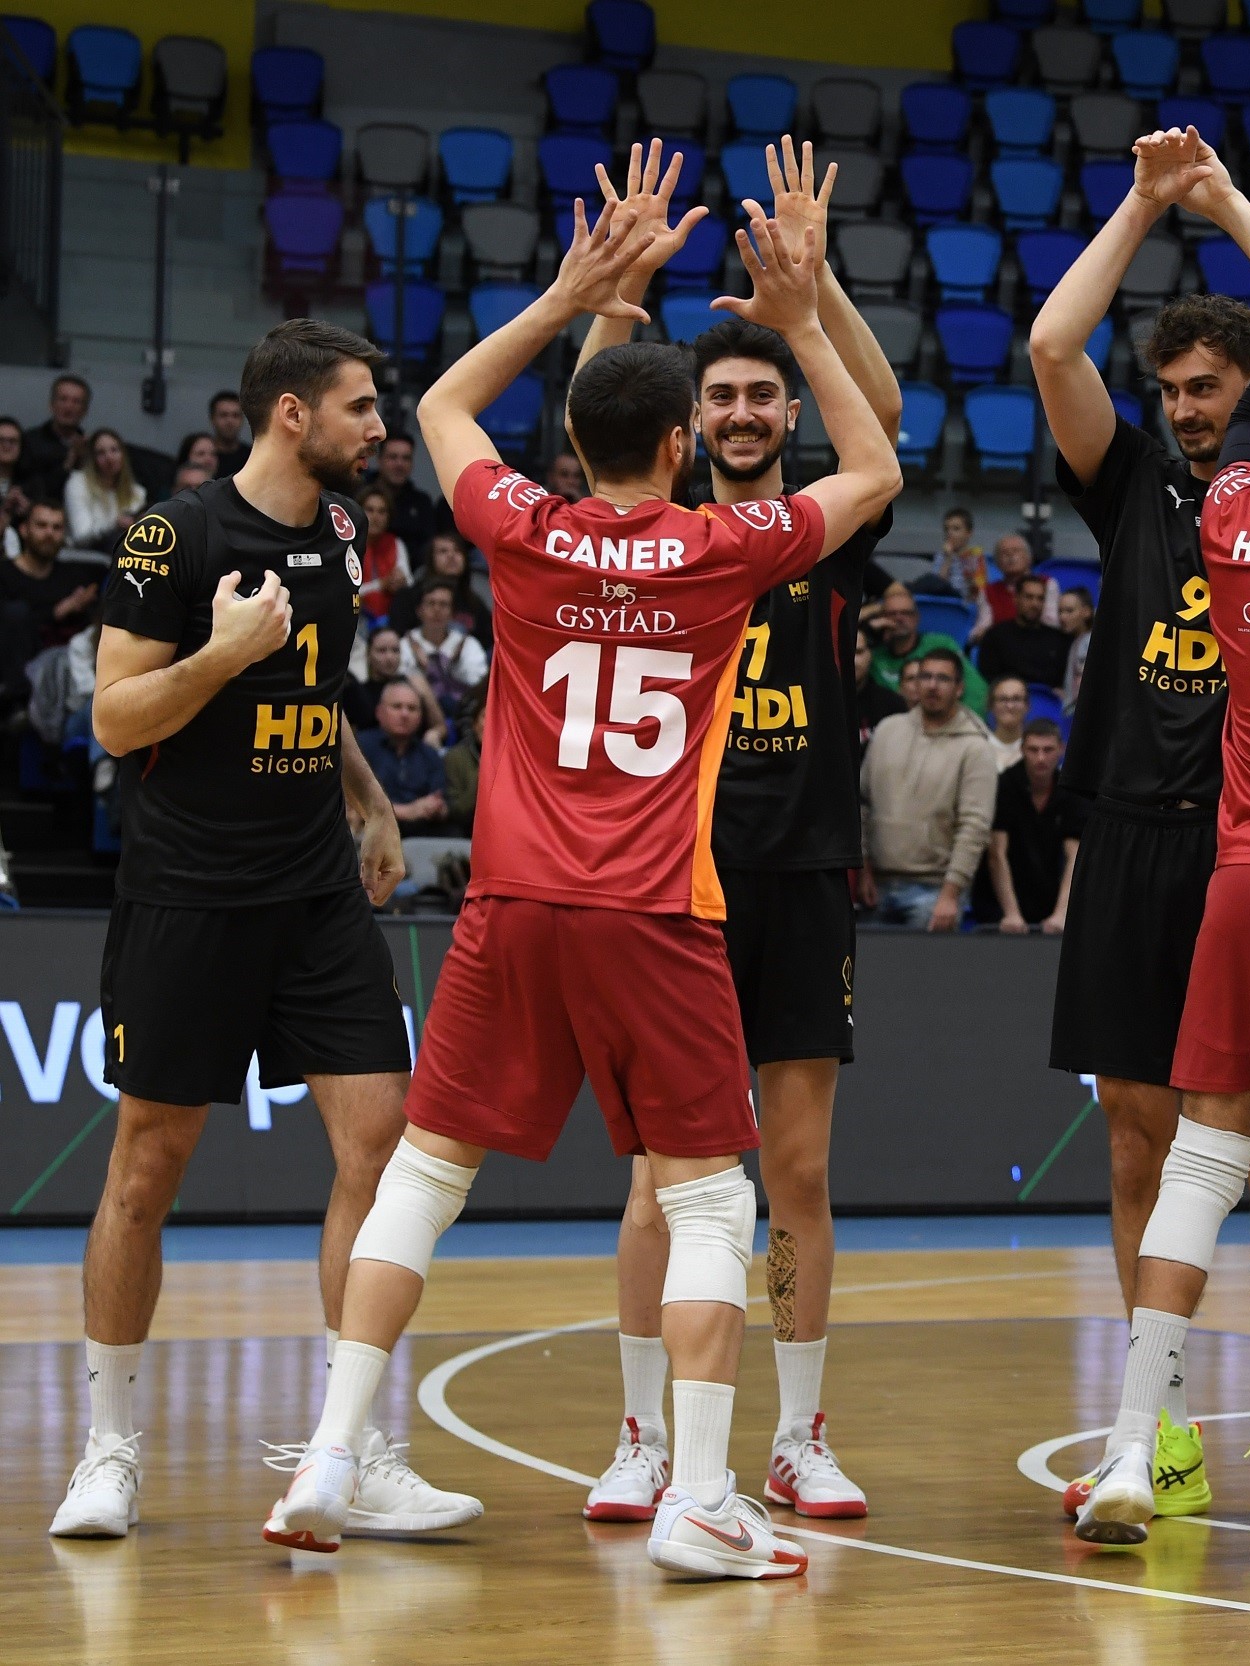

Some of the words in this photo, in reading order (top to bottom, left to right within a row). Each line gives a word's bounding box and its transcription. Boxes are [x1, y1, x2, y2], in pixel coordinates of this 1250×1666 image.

[129, 524, 165, 546] A11
[544, 529, 686, 571] CANER
[117, 556, 170, 576] HOTELS
[788, 580, 810, 597] HD
[1175, 575, 1212, 622] 9
[555, 604, 677, 634] GSYİAD
[296, 623, 319, 687] 1
[1141, 620, 1227, 672] HD
[252, 701, 339, 750] HDI
[541, 640, 694, 778] 15
[727, 729, 809, 753] İGORTA
[250, 754, 334, 774] SİGORTA
[113, 1023, 125, 1063] 1
